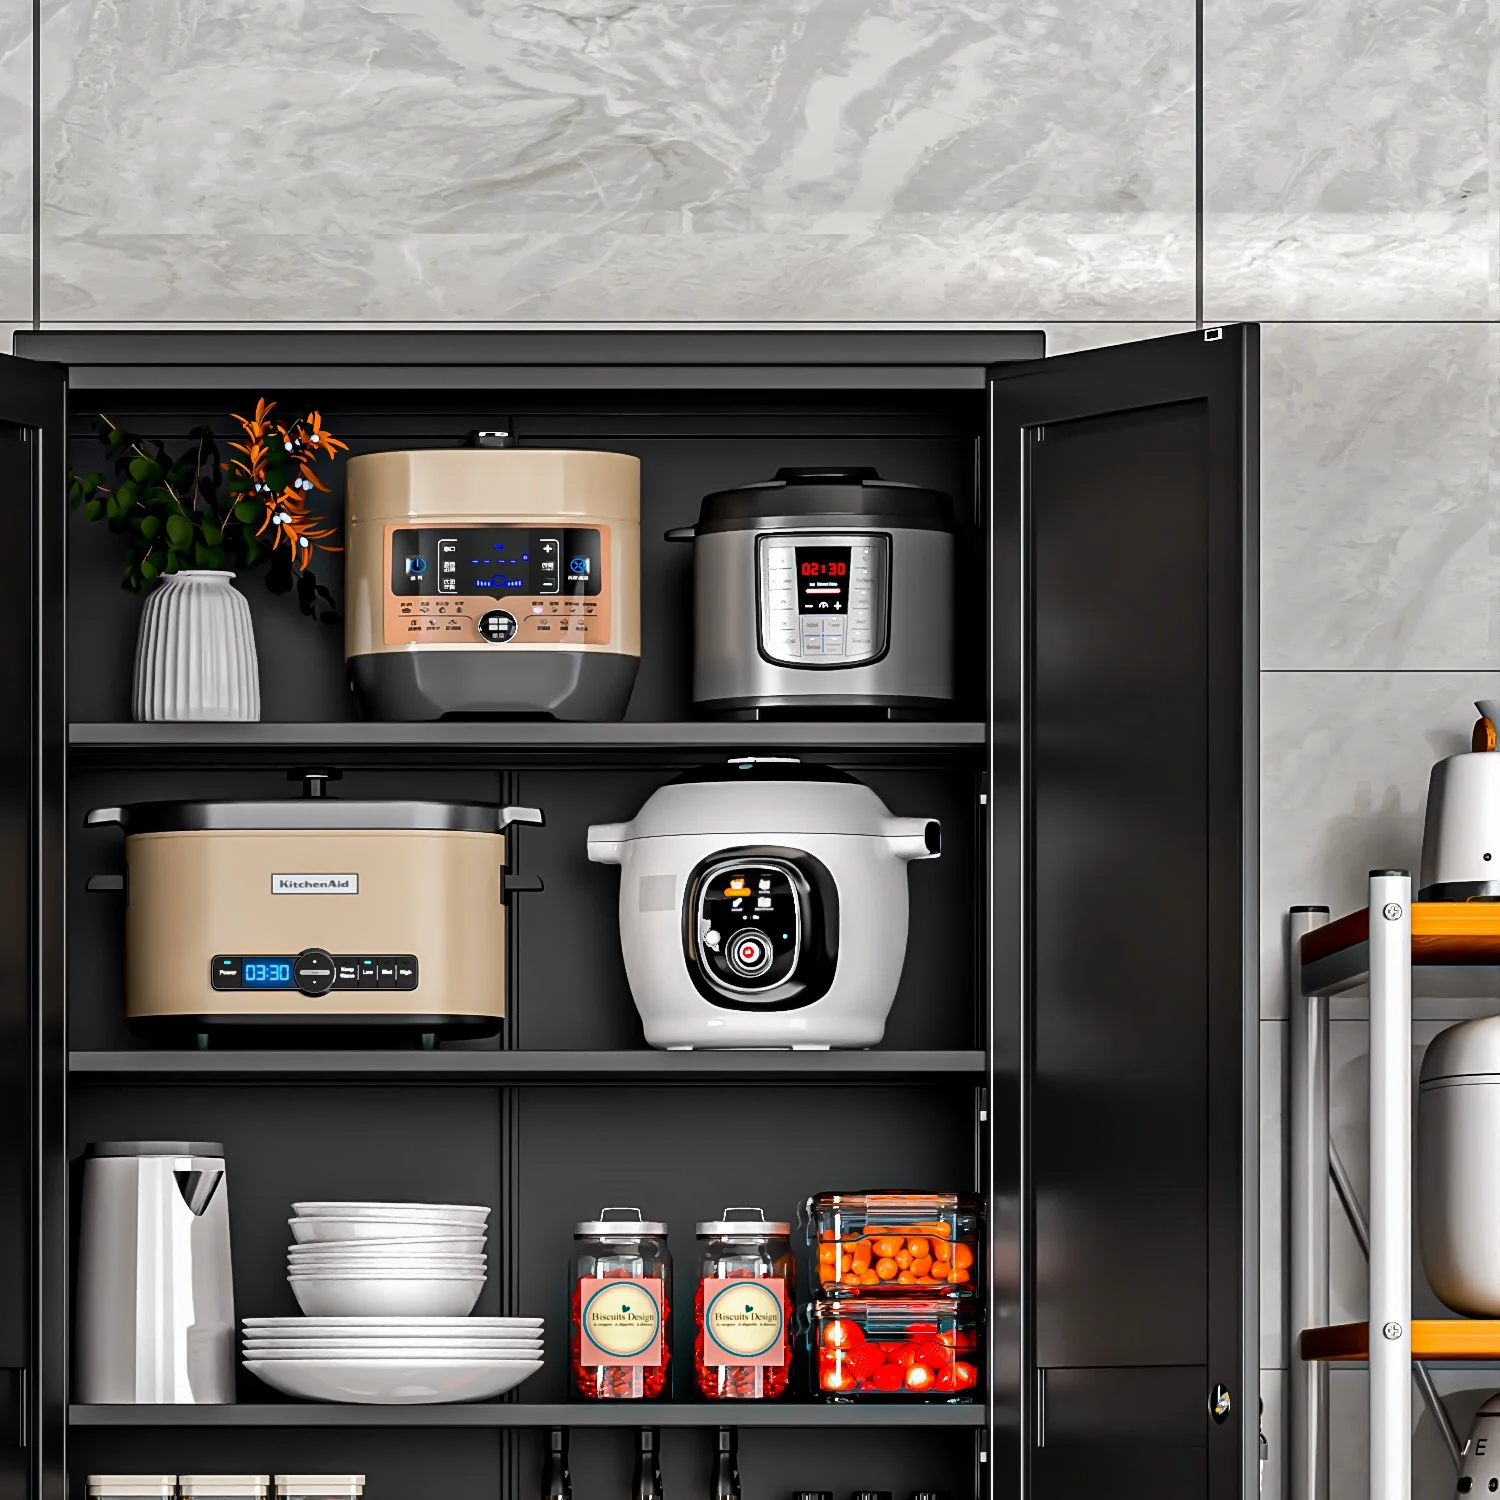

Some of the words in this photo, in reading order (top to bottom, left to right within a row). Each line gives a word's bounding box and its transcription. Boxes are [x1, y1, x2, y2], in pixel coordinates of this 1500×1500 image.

[801, 562, 846, 576] 02:30
[279, 879, 349, 889] KitchenAid
[245, 964, 290, 981] 03:30
[592, 1312, 626, 1321] Biscuits
[628, 1312, 654, 1322] Design
[715, 1312, 749, 1321] Biscuits
[751, 1312, 777, 1322] Design
